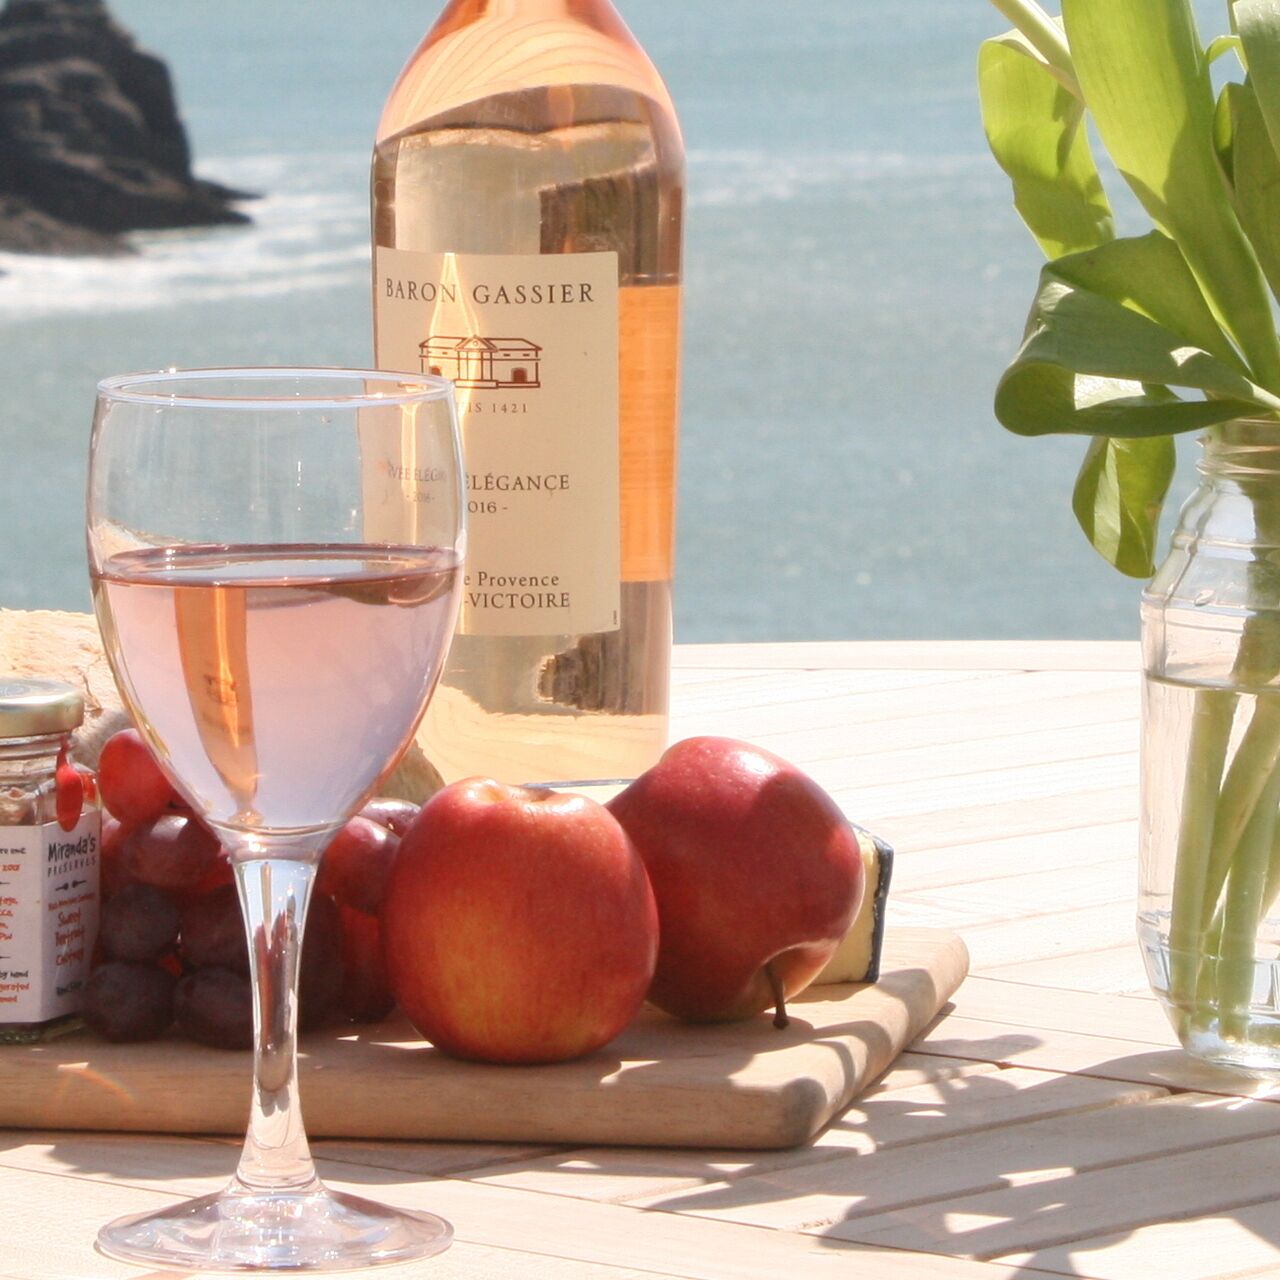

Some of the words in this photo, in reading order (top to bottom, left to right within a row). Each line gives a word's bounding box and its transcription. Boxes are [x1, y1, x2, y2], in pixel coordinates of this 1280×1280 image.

[386, 278, 457, 304] BARON
[472, 283, 594, 305] GASSIER
[492, 403, 528, 413] 1421
[467, 501, 497, 514] 016
[478, 571, 560, 587] Provence
[464, 593, 570, 609] -VICTOIRE
[48, 832, 96, 862] Miranda's
